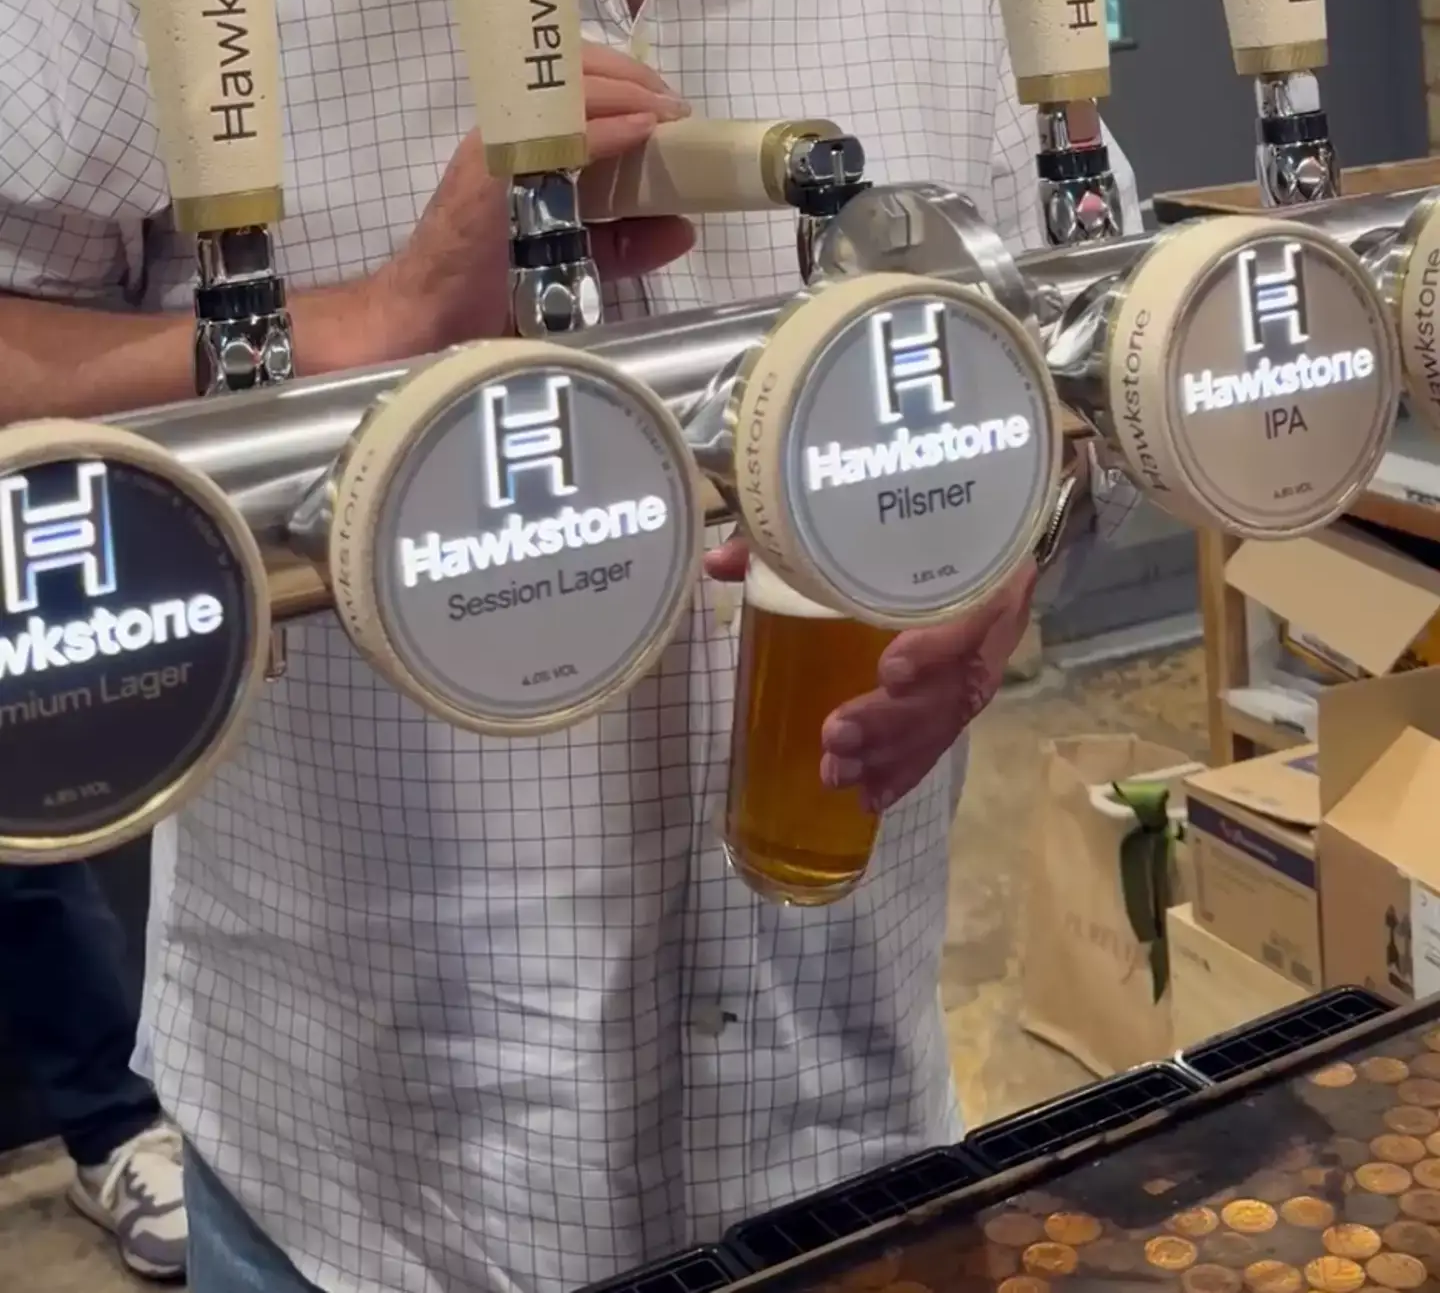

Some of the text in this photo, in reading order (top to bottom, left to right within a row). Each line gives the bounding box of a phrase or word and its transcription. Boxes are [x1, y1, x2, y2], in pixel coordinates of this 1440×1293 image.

[1182, 347, 1374, 415] Hawkstone
[806, 414, 1031, 491] Hawkstone
[1264, 405, 1308, 440] IPA
[877, 480, 976, 525] Pilsner
[400, 494, 668, 588] Hawkstone
[447, 559, 634, 622] Session Lager
[0, 592, 224, 679] wkstone
[0, 661, 194, 727] mium Lager
